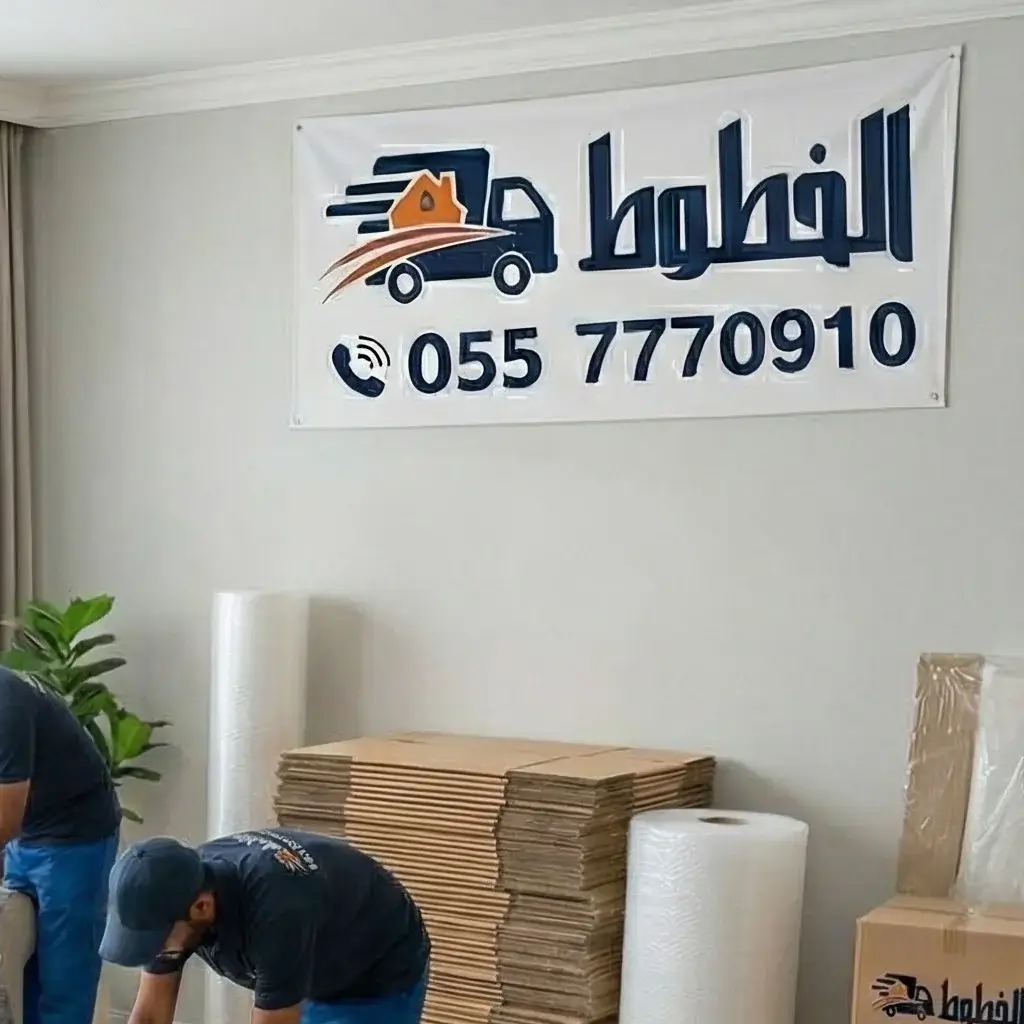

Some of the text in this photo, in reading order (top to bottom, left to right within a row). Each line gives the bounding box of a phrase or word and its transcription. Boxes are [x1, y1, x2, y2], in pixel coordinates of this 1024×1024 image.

[578, 103, 914, 280] الخطوط
[407, 301, 917, 397] 055 7770910
